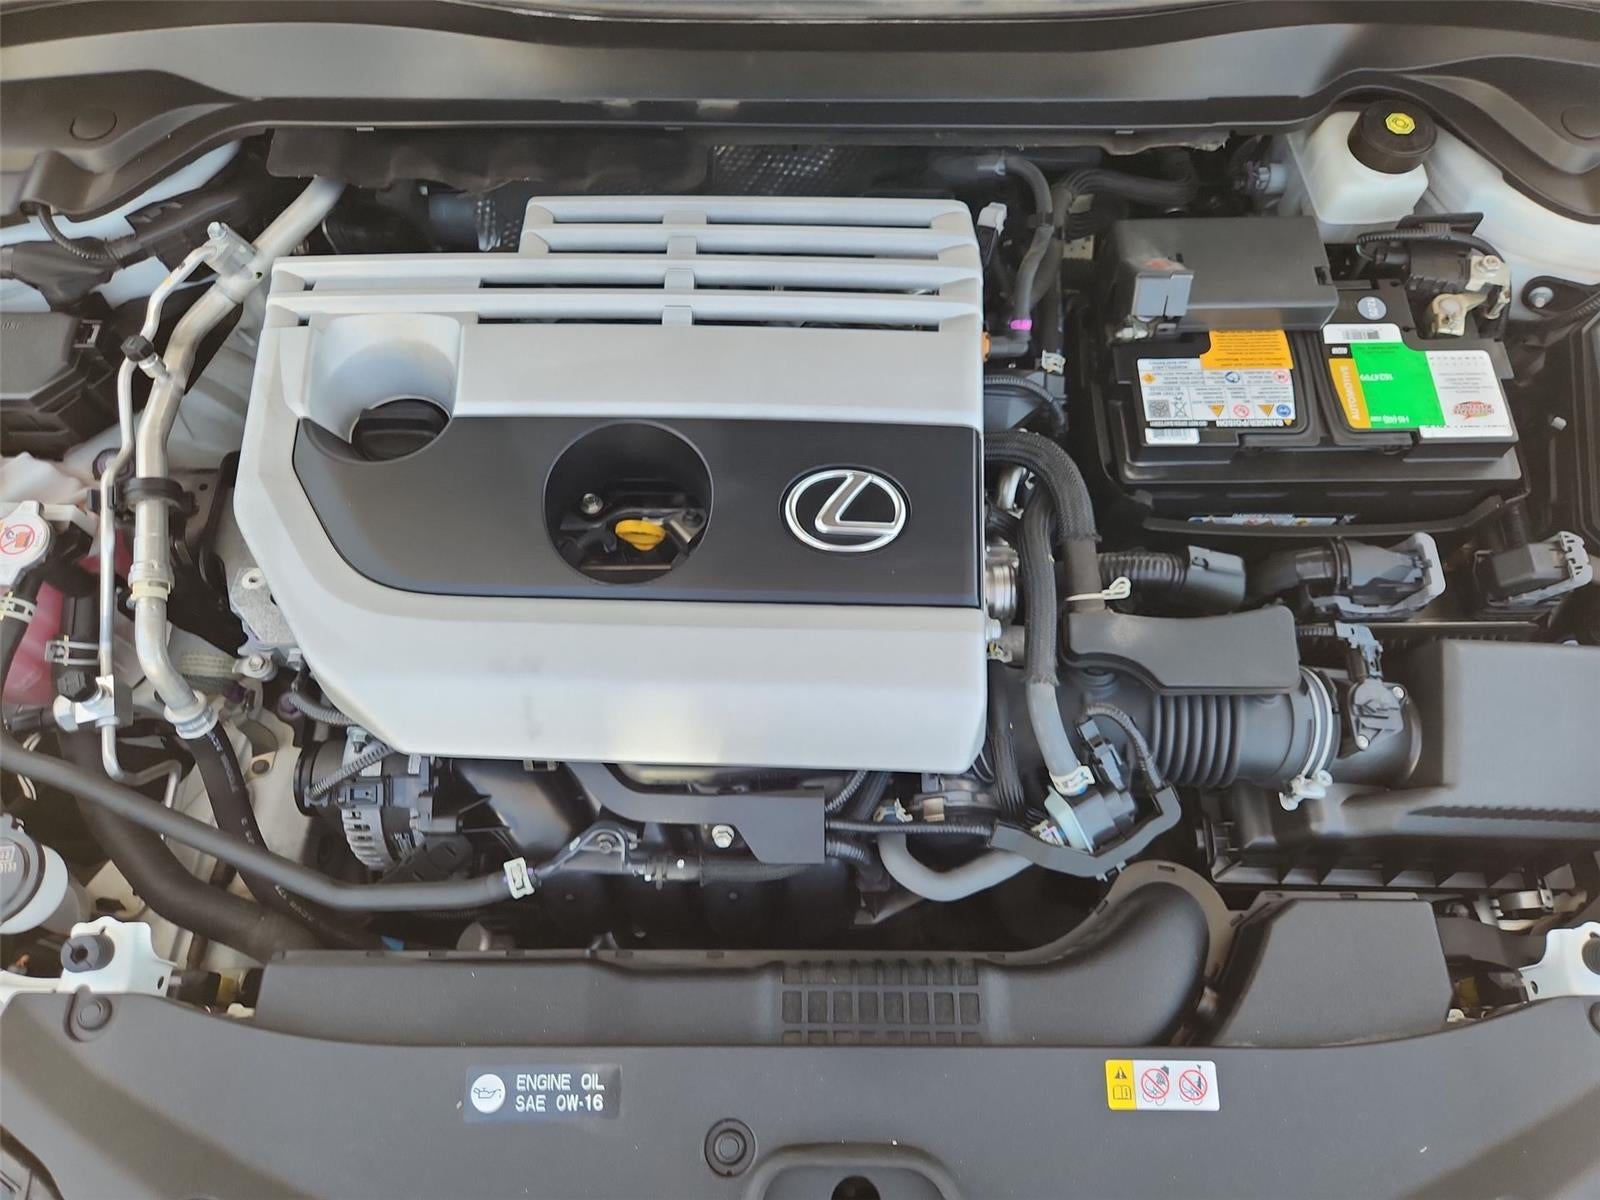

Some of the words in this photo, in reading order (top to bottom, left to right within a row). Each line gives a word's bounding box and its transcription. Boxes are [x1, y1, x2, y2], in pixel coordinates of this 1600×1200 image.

[516, 1073, 572, 1091] ENGINE
[581, 1073, 605, 1091] OIL
[515, 1095, 547, 1112] SAE
[556, 1094, 604, 1112] 0W-16
